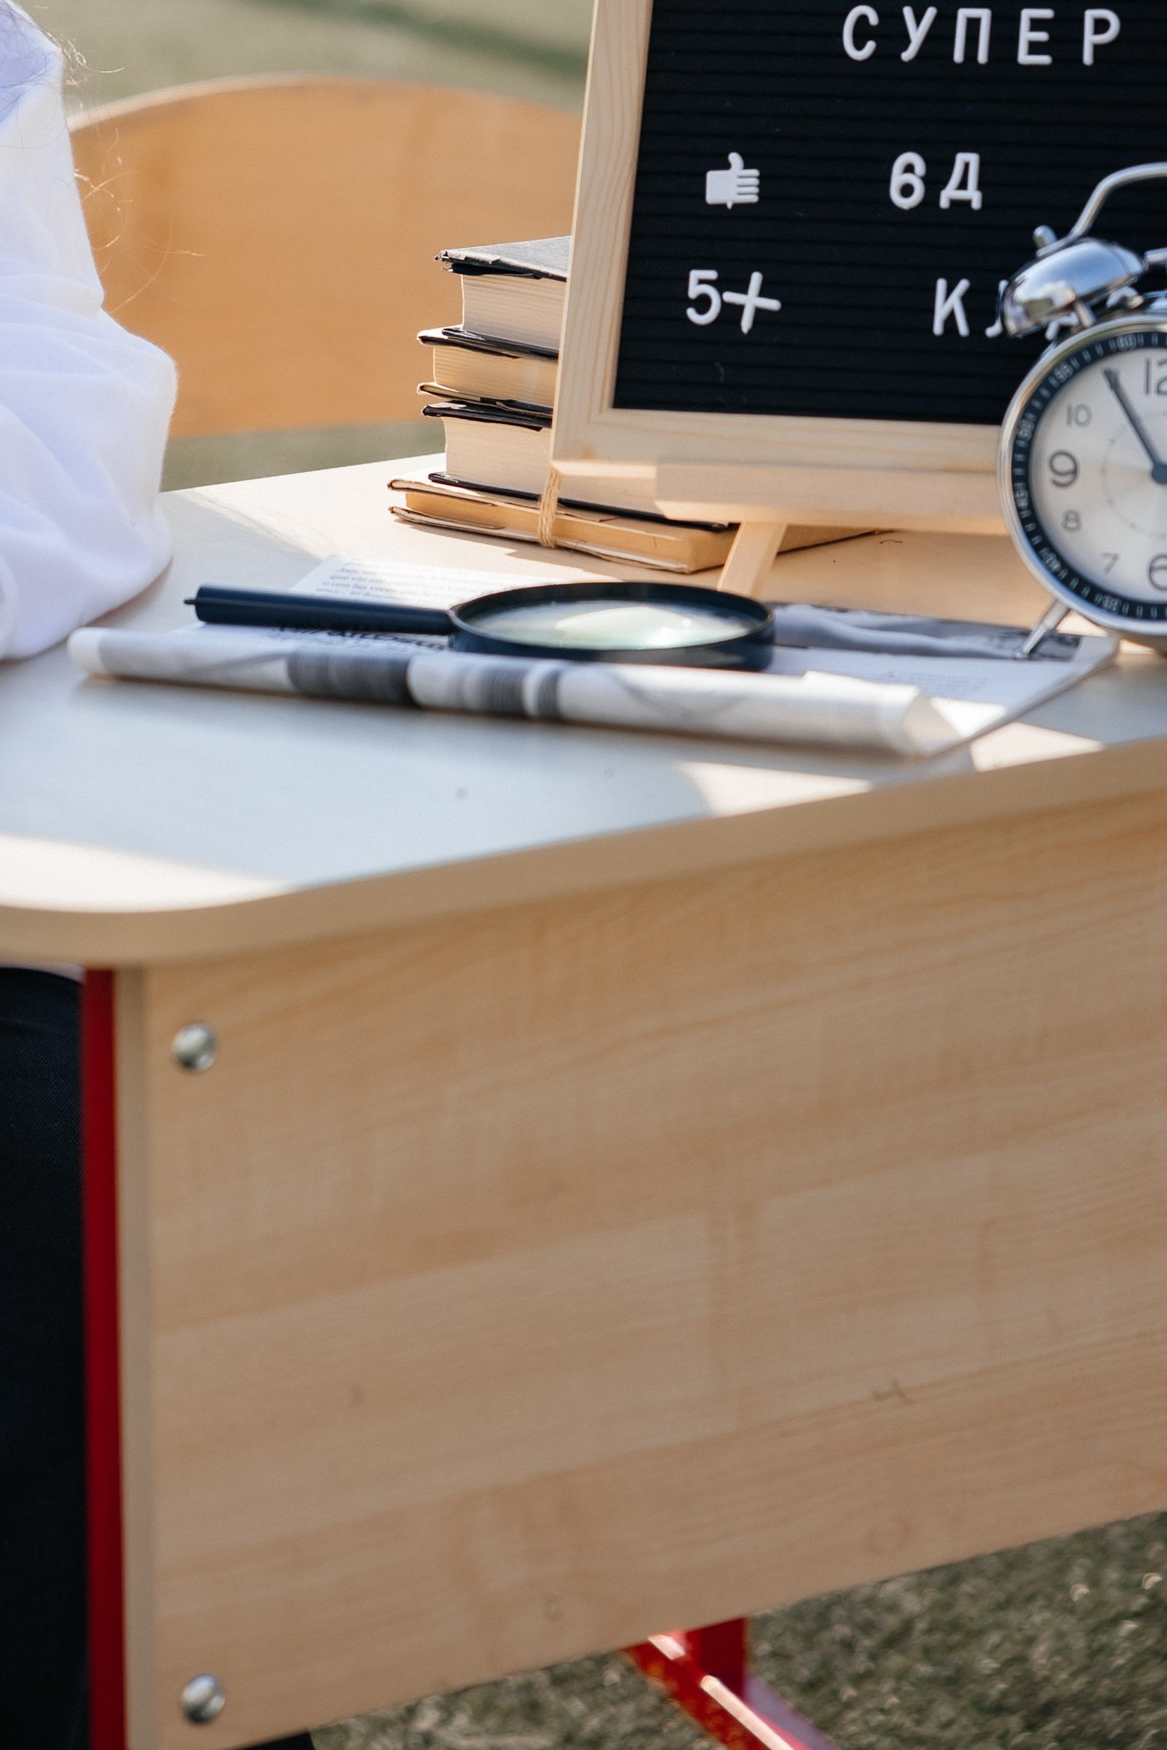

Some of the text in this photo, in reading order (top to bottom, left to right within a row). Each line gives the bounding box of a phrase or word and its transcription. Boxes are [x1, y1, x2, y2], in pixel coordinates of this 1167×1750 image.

[842, 4, 1121, 66] СУПЕР
[889, 151, 983, 210] 6Д
[686, 269, 782, 334] 5+
[1066, 403, 1092, 427] 10
[1049, 450, 1078, 487] 9
[1061, 509, 1082, 533] 8
[1100, 552, 1120, 575] 7
[1147, 552, 1167, 591] 6
